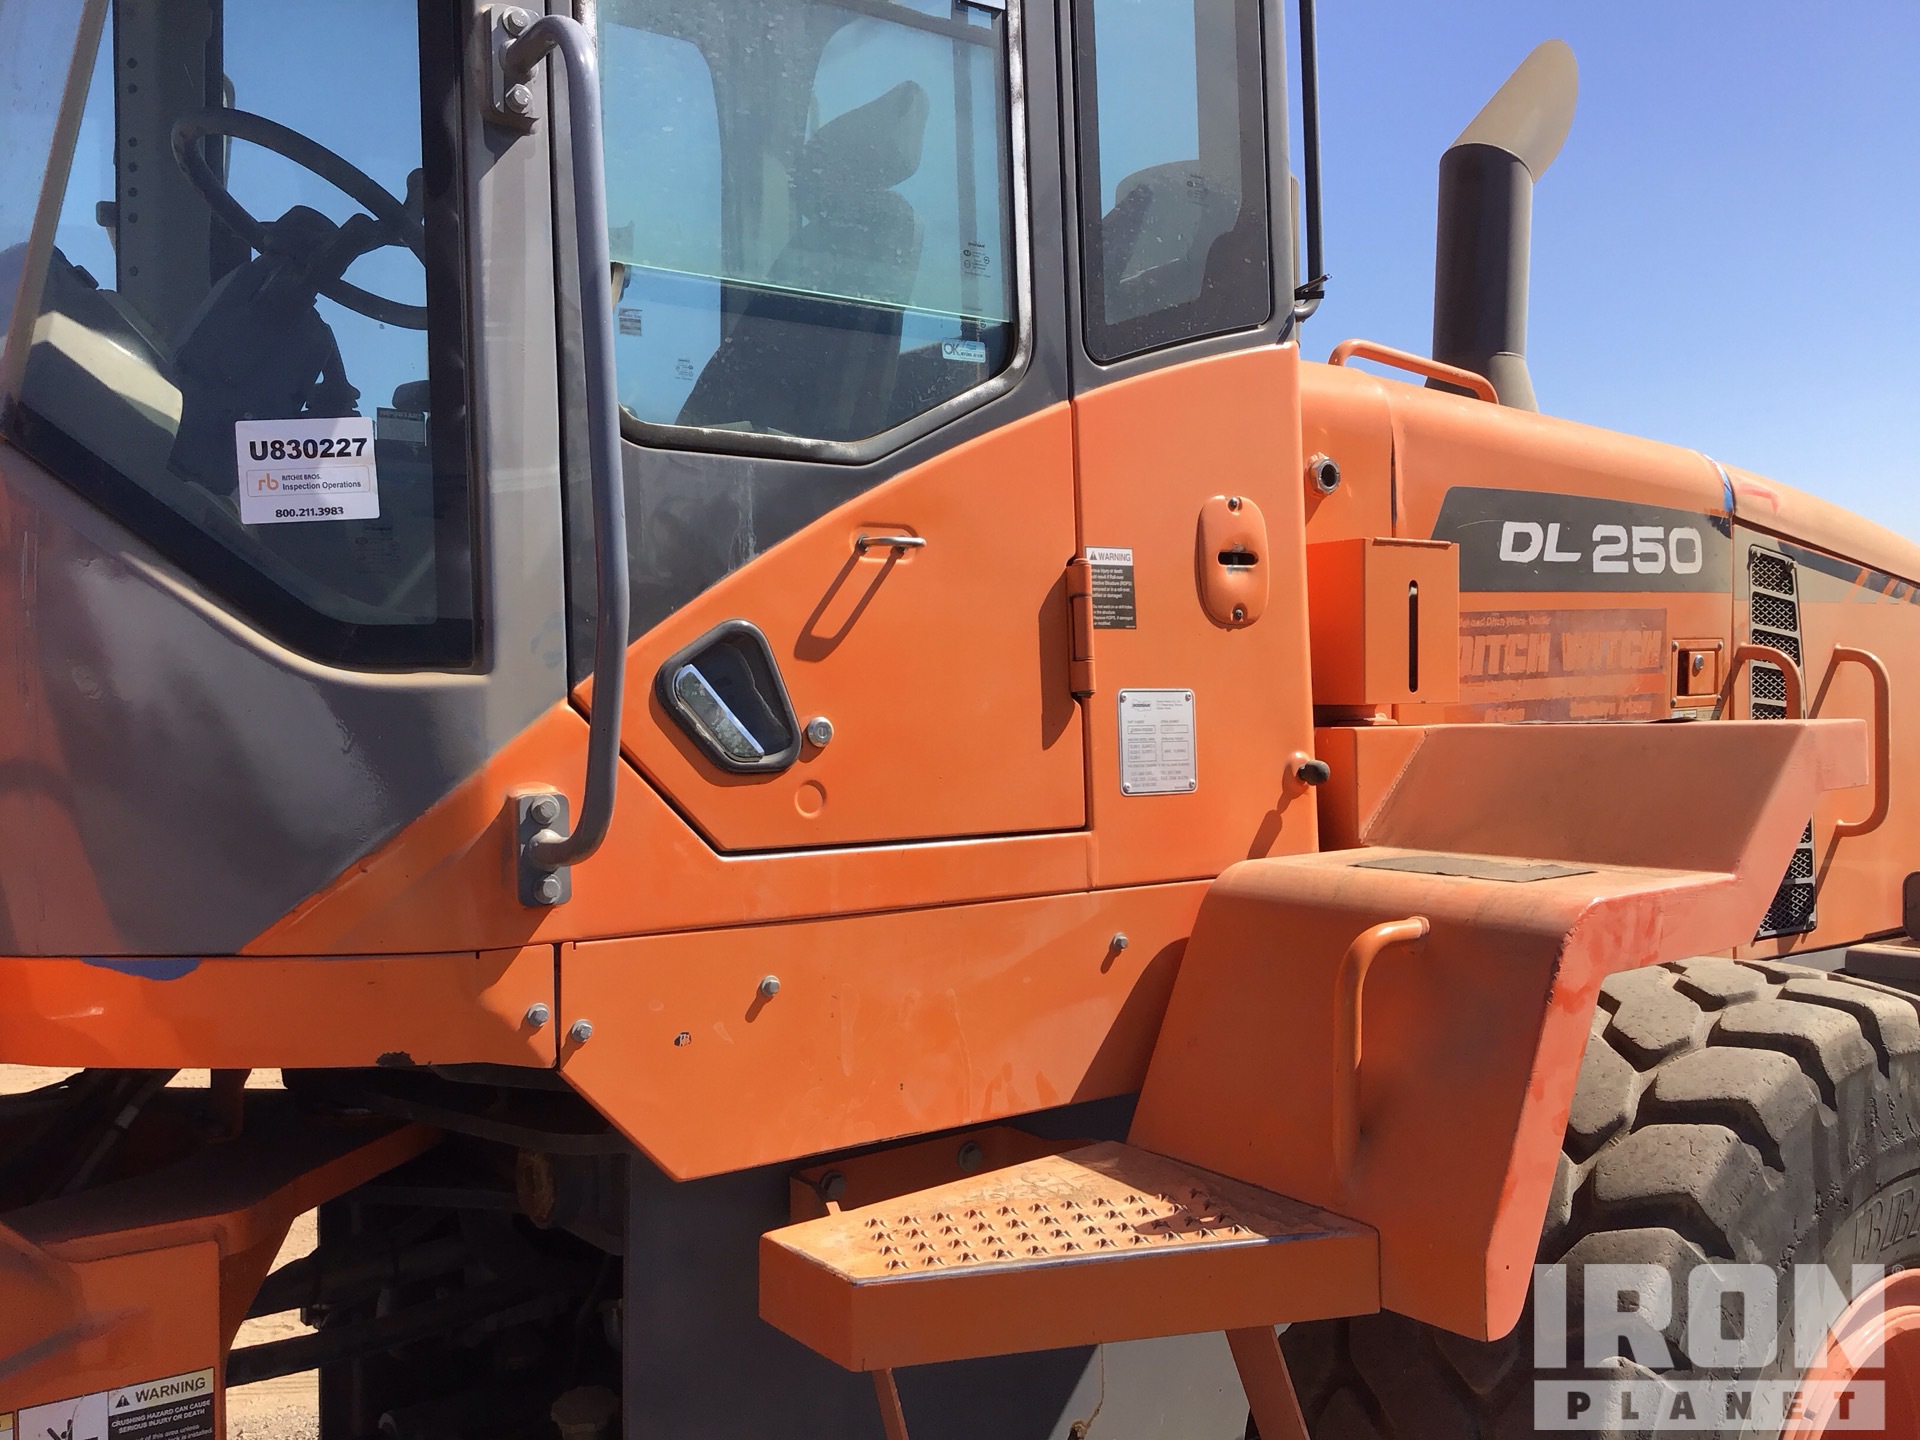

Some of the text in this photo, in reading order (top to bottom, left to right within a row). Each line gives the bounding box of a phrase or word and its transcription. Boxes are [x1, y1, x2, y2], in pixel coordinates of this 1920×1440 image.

[250, 438, 367, 460] U830227
[258, 473, 279, 491] rb
[282, 481, 362, 492] Inspection Operations
[276, 507, 344, 518] 800.211.3983
[1098, 552, 1131, 562] WARNING
[1500, 521, 1702, 575] DL 250
[135, 1378, 206, 1402] WARNING
[112, 1400, 211, 1428] CRUSHING HAZARD CAN CAUSE
[118, 1422, 148, 1434] SERIOUS
[148, 1416, 172, 1426] INJURY
[184, 1408, 206, 1418] DEATH
[152, 1432, 164, 1440] this
[180, 1424, 200, 1433] unless
